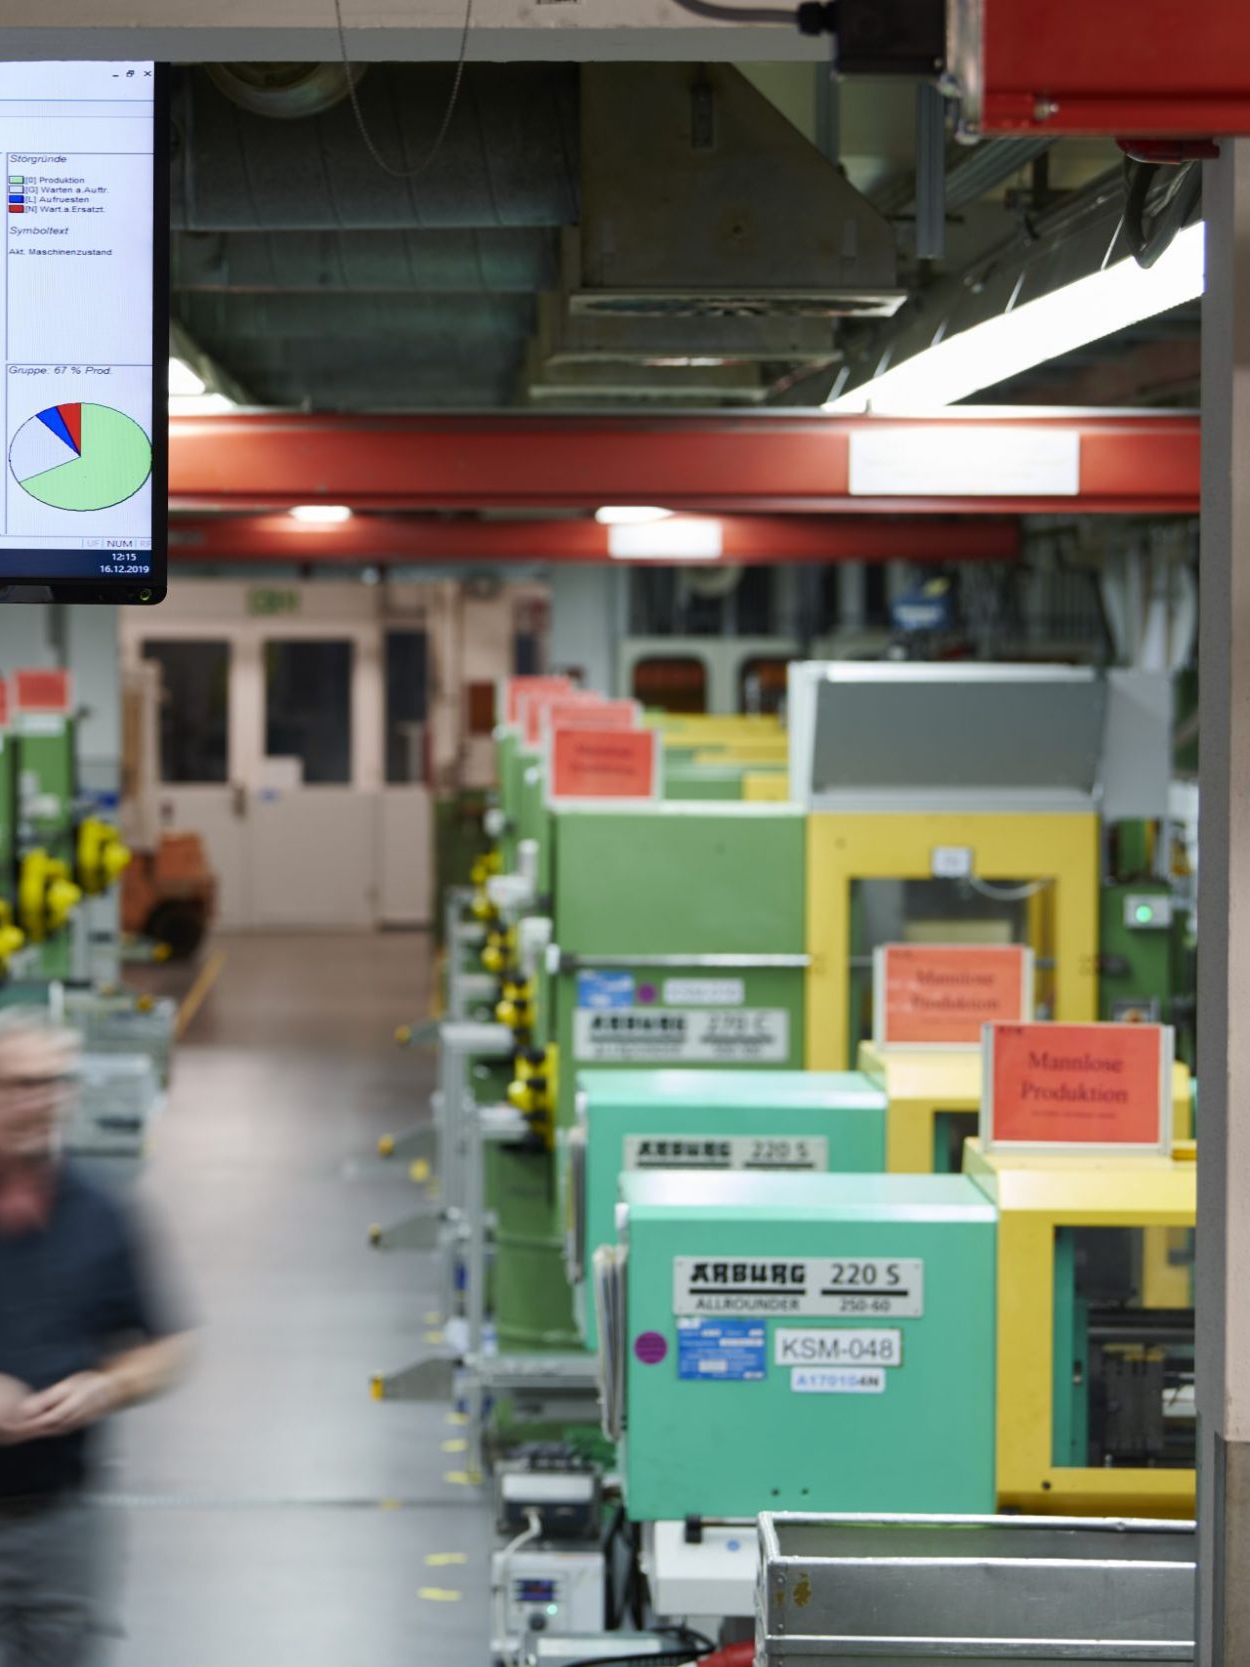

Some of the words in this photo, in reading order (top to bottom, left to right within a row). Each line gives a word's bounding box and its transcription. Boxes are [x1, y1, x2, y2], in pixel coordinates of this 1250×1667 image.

[10, 226, 68, 236] Symboltext
[9, 366, 50, 375] Gruppe:
[100, 565, 150, 573] 16.12.2019
[1028, 1052, 1122, 1073] Mannlose
[1020, 1081, 1129, 1104] Produktion
[690, 1263, 805, 1284] ARBURG
[831, 1264, 877, 1285] 220
[887, 1264, 900, 1285] S
[696, 1299, 799, 1310] ALLROUNDER
[840, 1300, 891, 1312] 250-60
[782, 1339, 893, 1359] KSM-048
